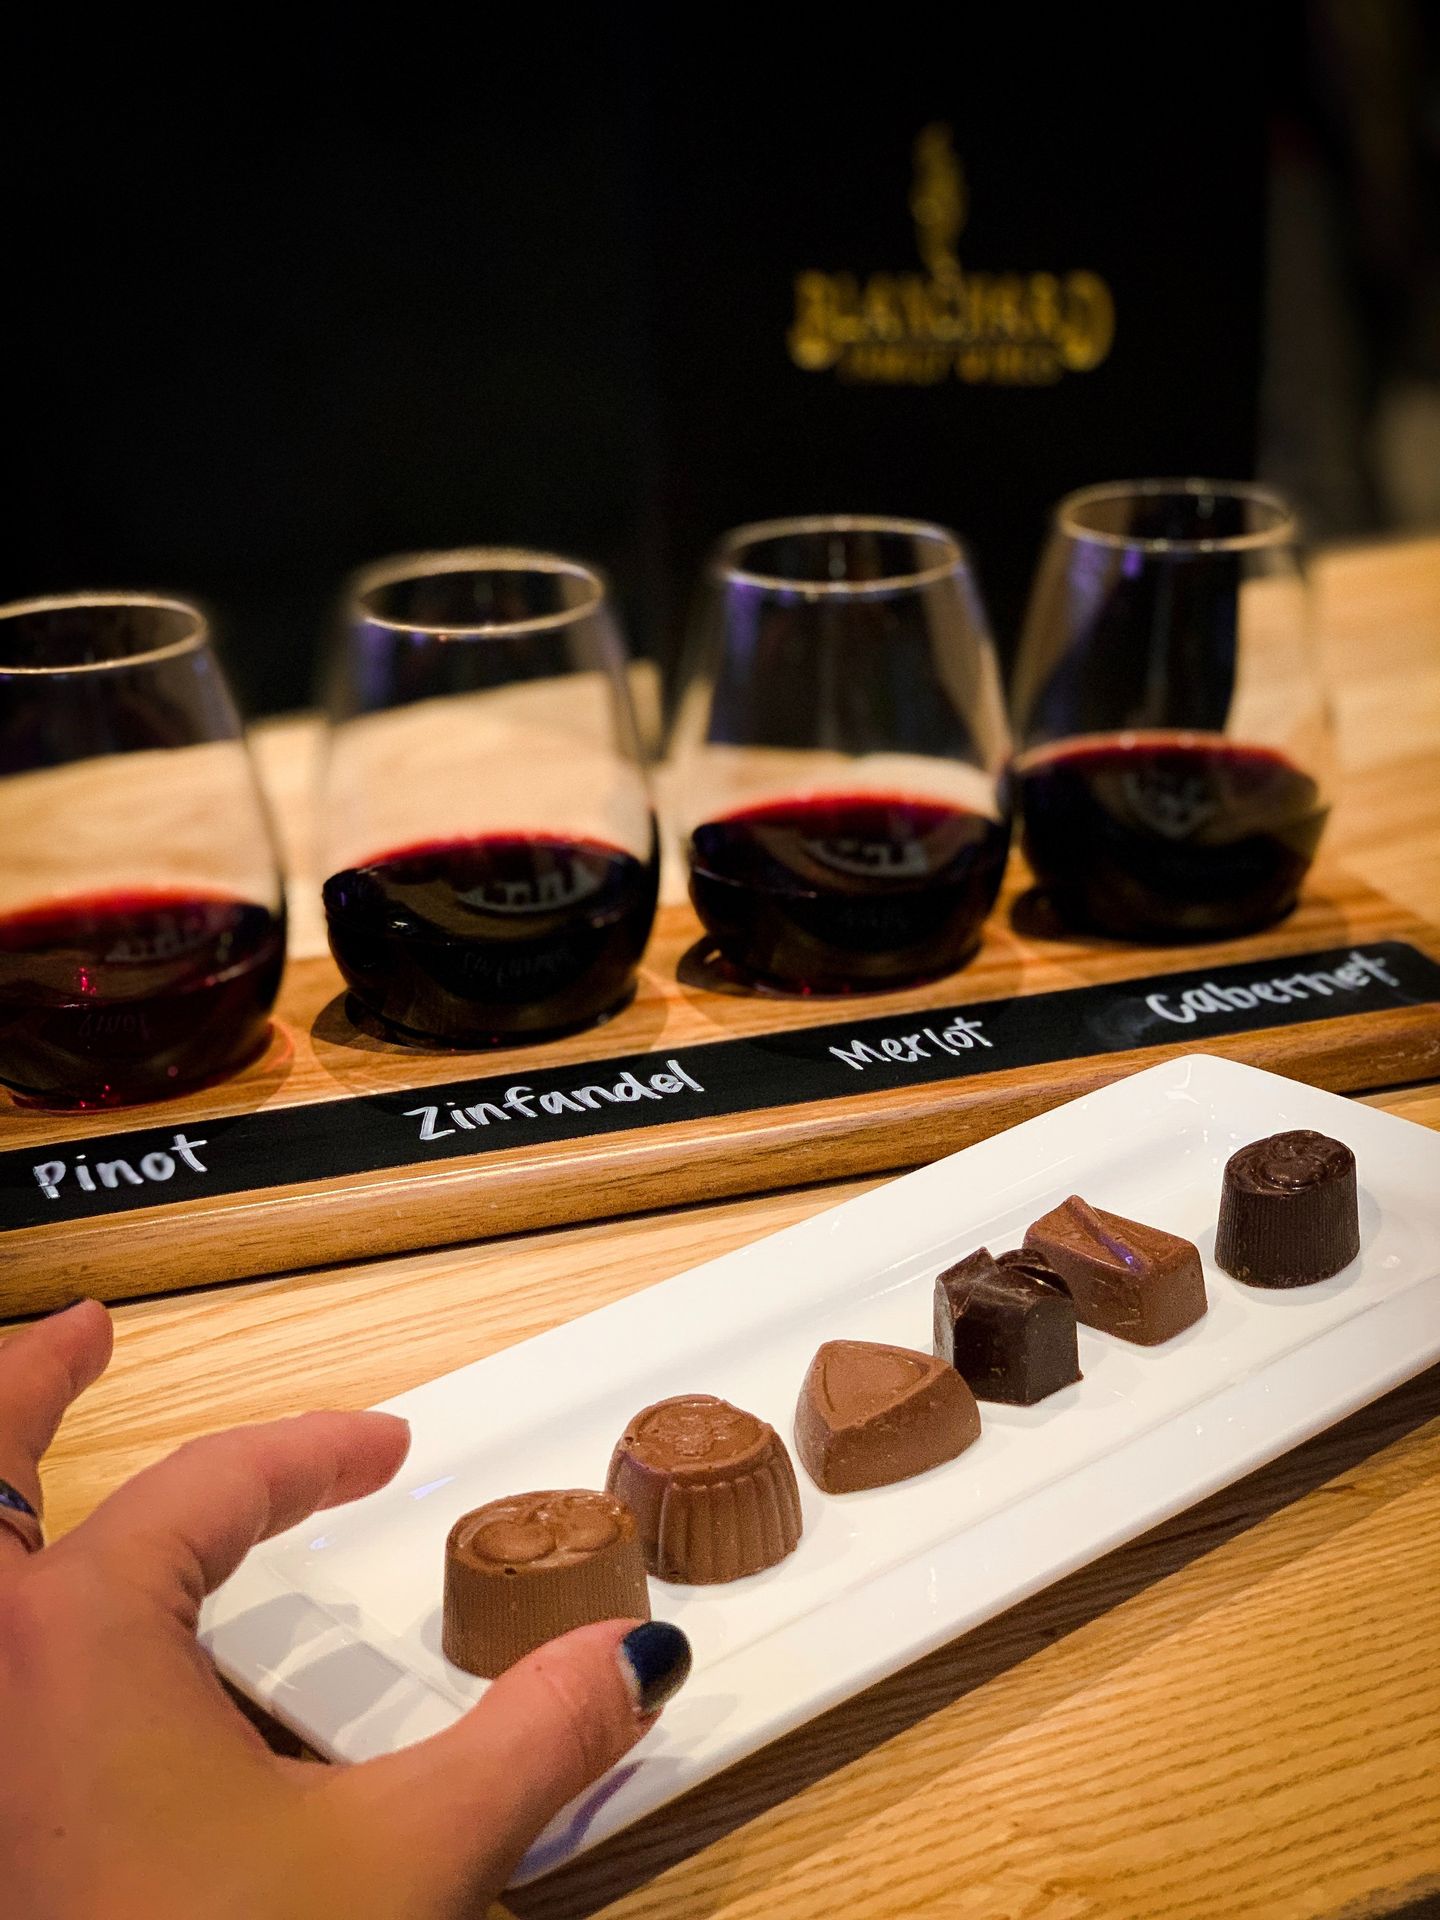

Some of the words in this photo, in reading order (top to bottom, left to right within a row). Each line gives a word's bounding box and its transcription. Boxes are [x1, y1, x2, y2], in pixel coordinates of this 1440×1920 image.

[1145, 952, 1400, 1025] Cabernet
[828, 1016, 994, 1072] Merlot
[403, 1059, 705, 1142] Zinfandel
[34, 1133, 208, 1200] Pinot
